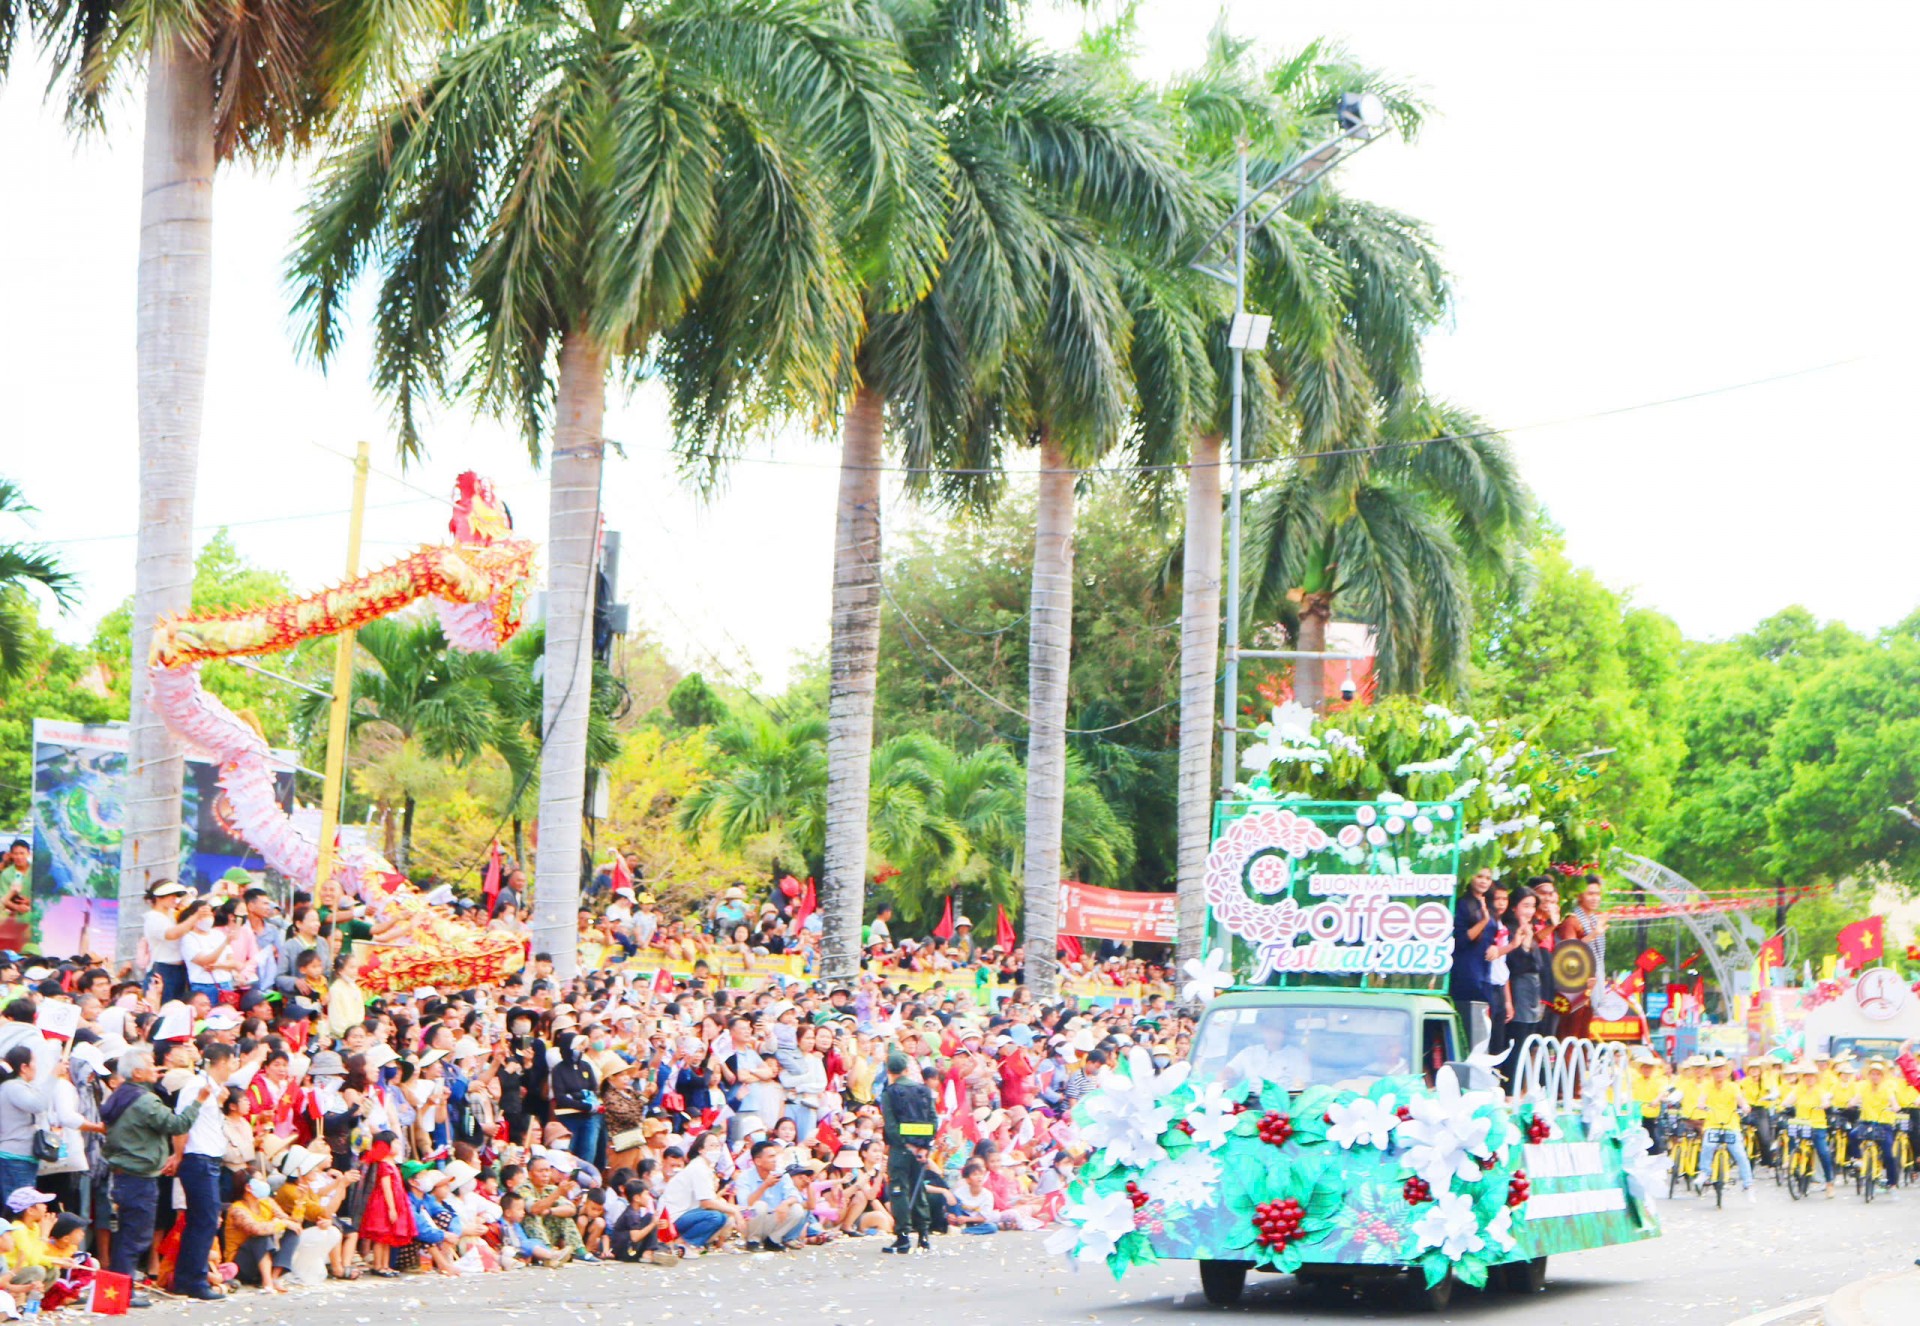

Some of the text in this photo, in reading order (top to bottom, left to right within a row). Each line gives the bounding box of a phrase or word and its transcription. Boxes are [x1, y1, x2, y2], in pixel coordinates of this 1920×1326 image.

[1312, 877, 1450, 891] BUON MA THUOT
[1251, 942, 1449, 980] Festival 2025
